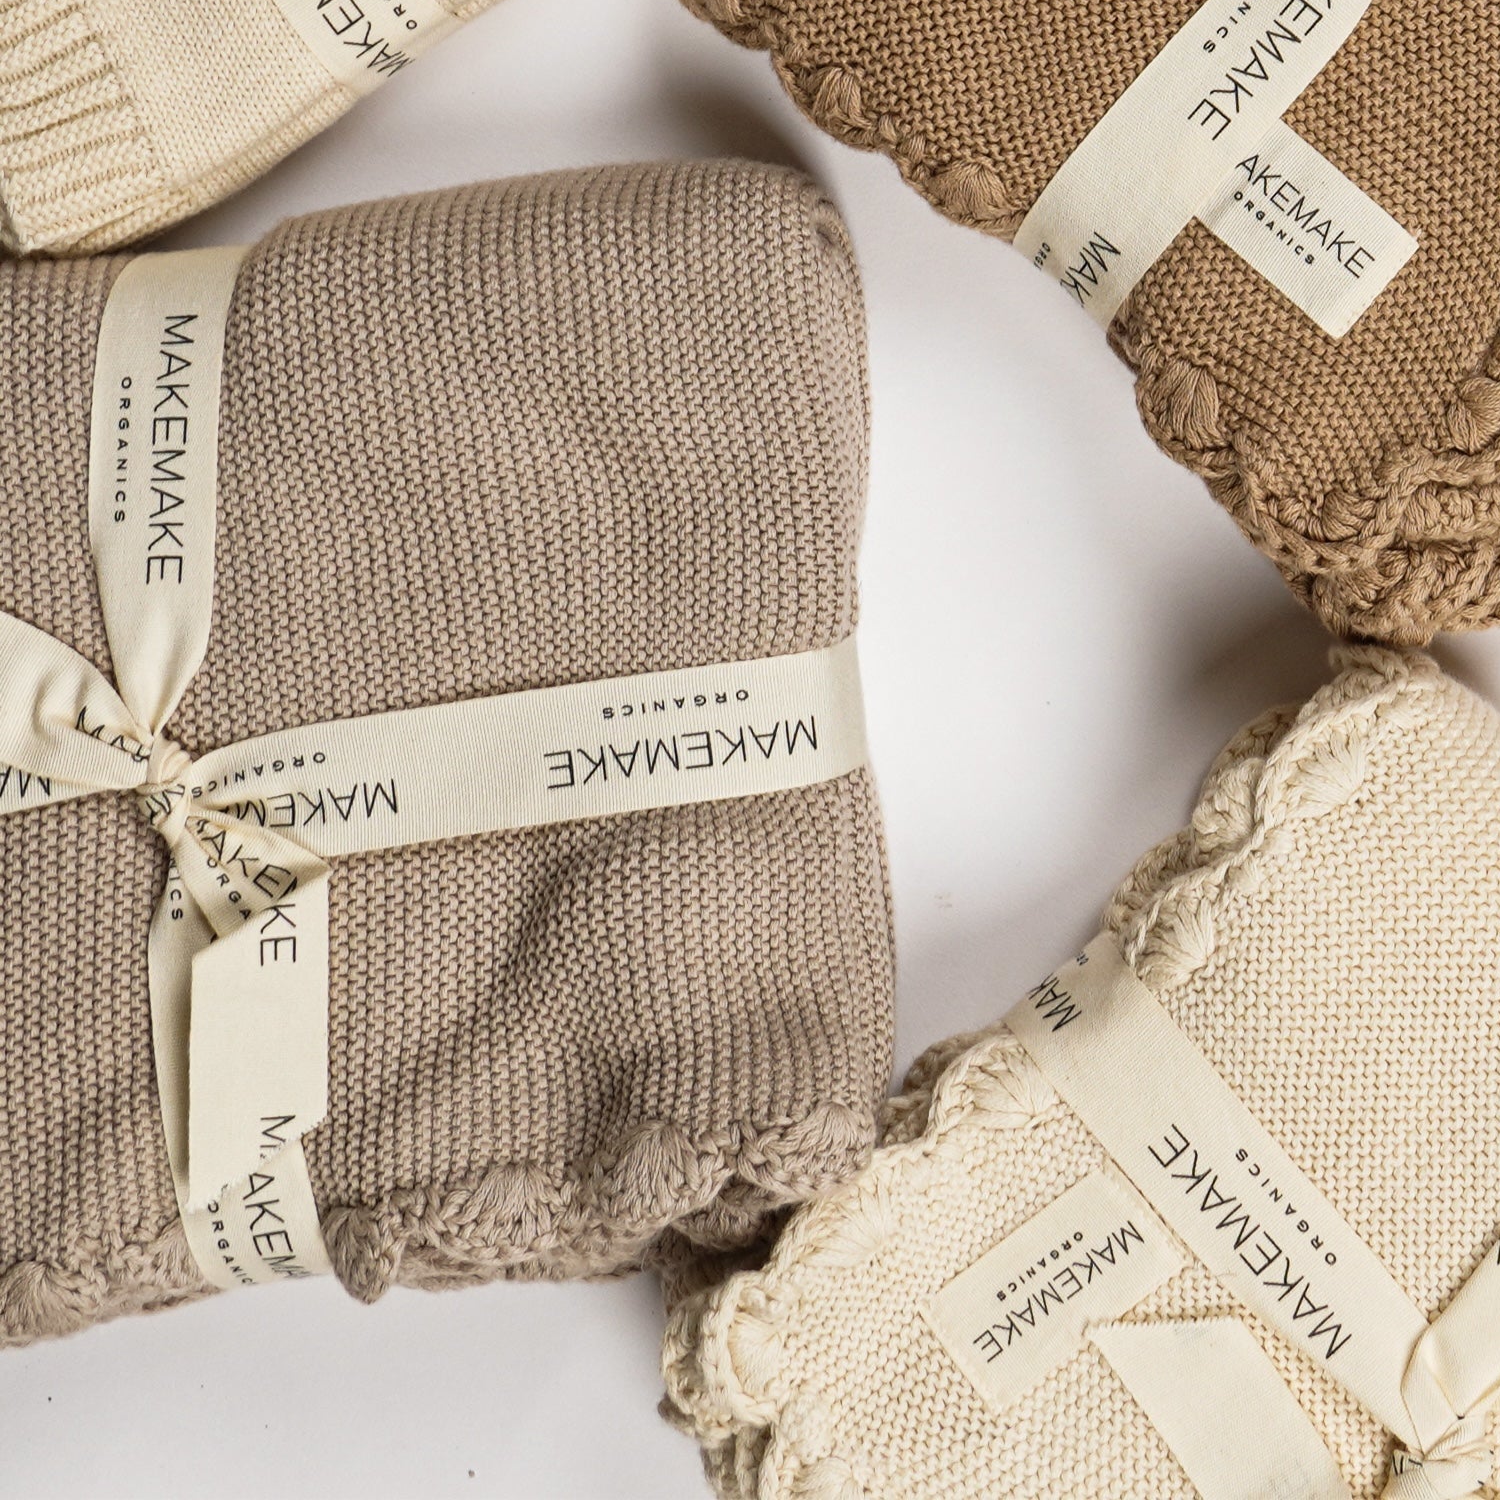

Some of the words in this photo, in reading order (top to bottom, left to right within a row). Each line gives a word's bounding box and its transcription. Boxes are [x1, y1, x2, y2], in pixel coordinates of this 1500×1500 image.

[1234, 190, 1315, 266] ORGANICS
[114, 376, 132, 523] ORGANICS
[146, 314, 198, 585] MAKEMAKE
[603, 689, 749, 719] ORGANICS
[191, 752, 326, 798] ORGANICS
[544, 715, 818, 790] MAKEMAKE
[1148, 1123, 1352, 1359] MAKEMAKE
[1235, 1148, 1337, 1265] ORGANICS
[973, 1220, 1144, 1363] MAKEMAKE
[997, 1231, 1083, 1301] ORGANICS
